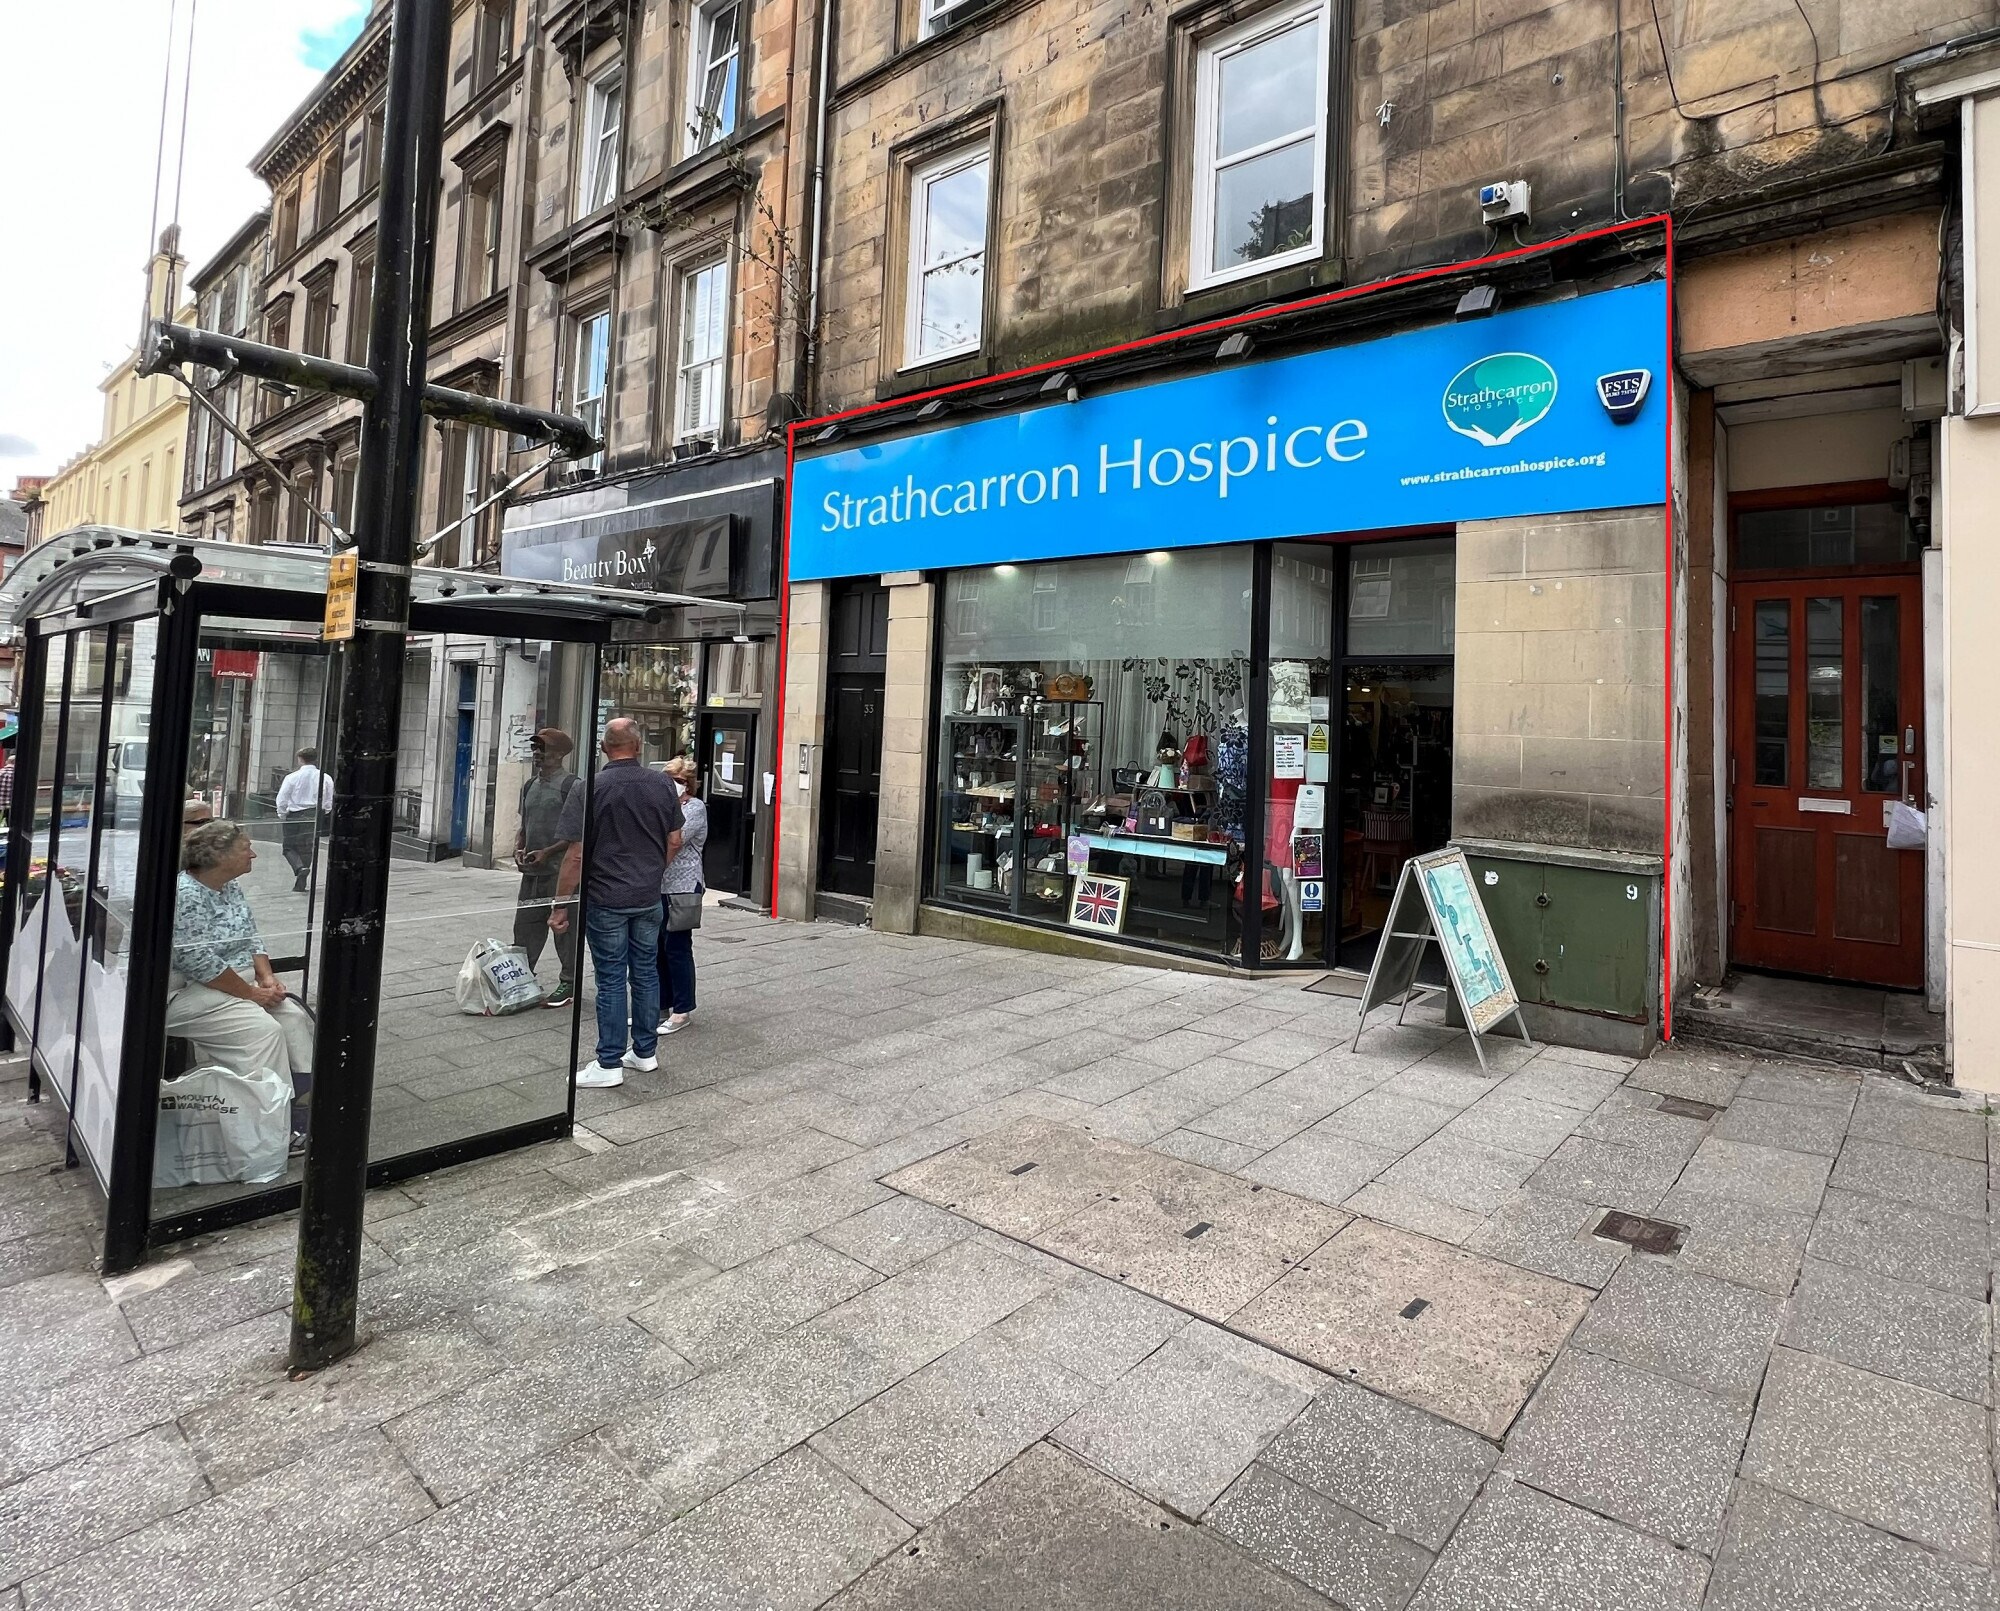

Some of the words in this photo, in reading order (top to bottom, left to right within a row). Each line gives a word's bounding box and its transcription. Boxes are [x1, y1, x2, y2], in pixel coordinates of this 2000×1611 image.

[1448, 380, 1552, 408] Strathcarron
[1605, 378, 1640, 392] FSTS
[1463, 396, 1535, 412] HOSPICE
[821, 463, 1079, 532] Strathcarron
[1099, 415, 1369, 497] Hospice
[1400, 452, 1606, 486] www.strathcarronhospice.org
[563, 558, 612, 582] Beauty
[616, 549, 646, 577] Box
[864, 704, 874, 714] 33
